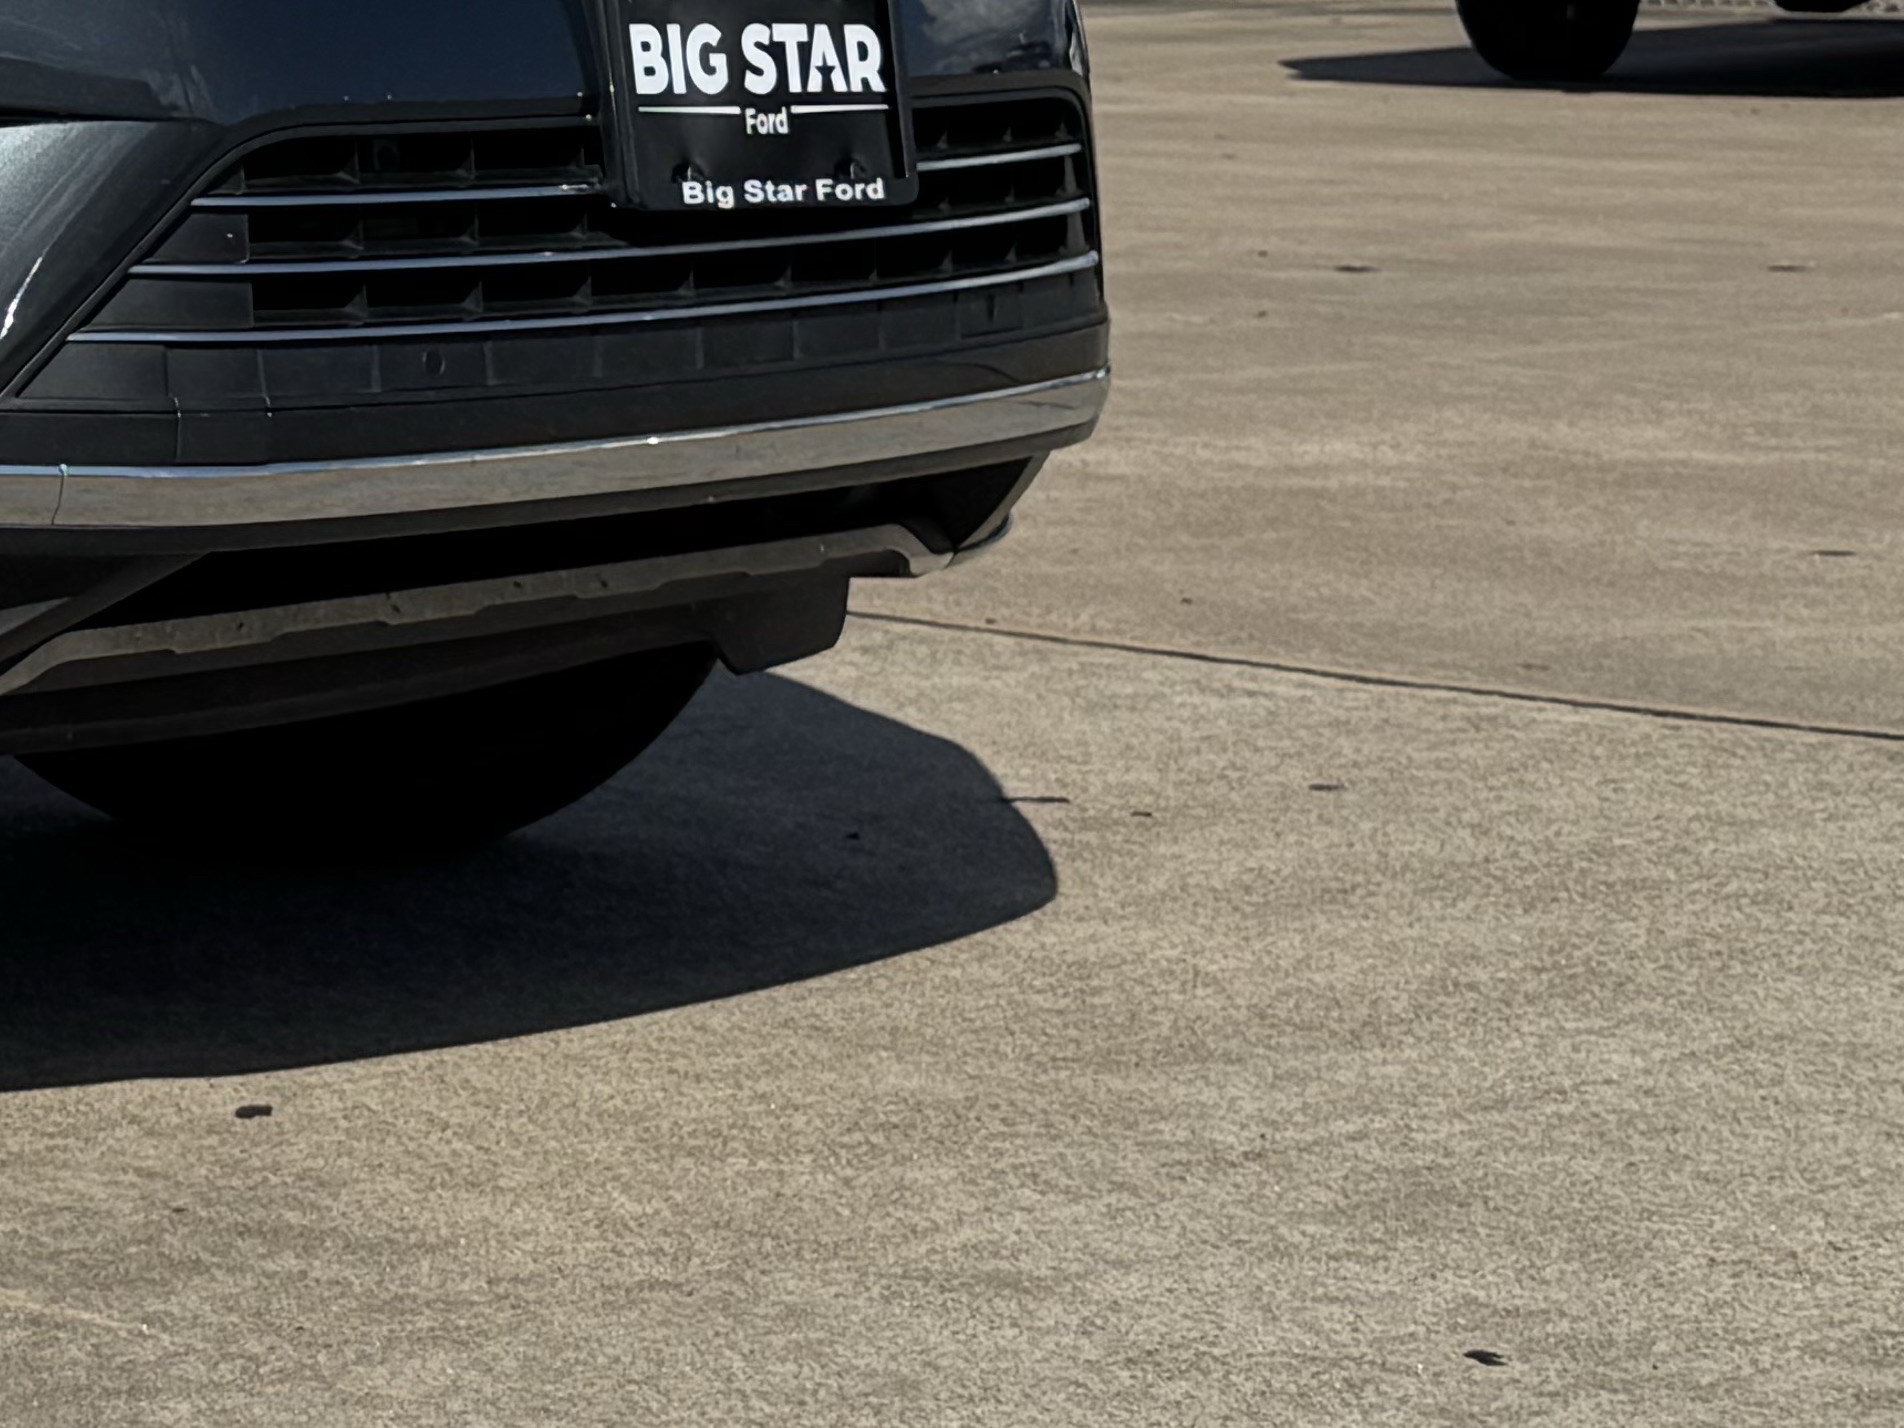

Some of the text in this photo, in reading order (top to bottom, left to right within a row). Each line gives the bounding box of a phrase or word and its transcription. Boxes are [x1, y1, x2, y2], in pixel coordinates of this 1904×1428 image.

[628, 22, 887, 95] BIG STAR
[745, 108, 789, 135] Ford
[682, 177, 885, 209] Big Star Ford
